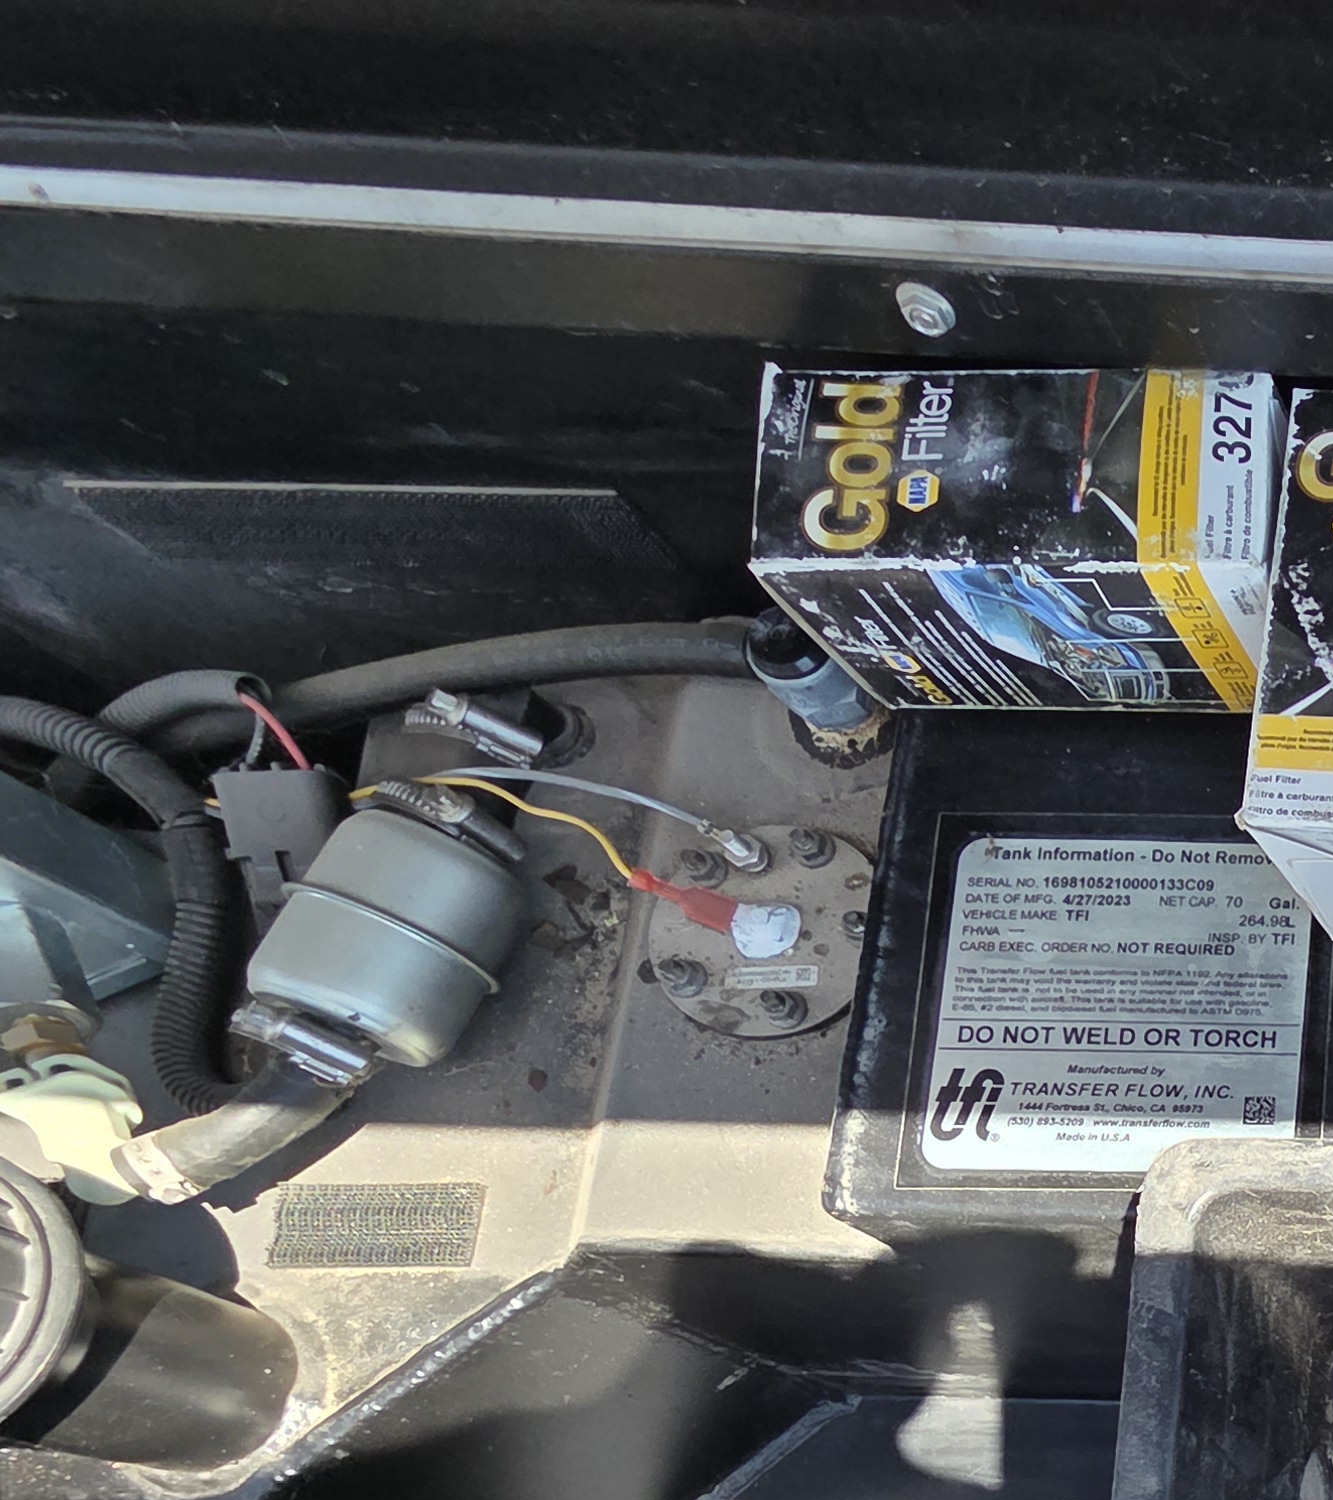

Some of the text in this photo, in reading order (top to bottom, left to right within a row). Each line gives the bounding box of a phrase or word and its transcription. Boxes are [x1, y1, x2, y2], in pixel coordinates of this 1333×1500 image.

[902, 381, 953, 461] Filter
[802, 381, 903, 551] Gold
[908, 476, 929, 505] NAPA
[993, 847, 1273, 866] Tank Information Do Not Remov
[967, 877, 1012, 889] SERIAL
[966, 893, 1131, 907] DATE OF 4/27/2023
[1159, 896, 1300, 910] NET 70 Gal.
[963, 908, 1089, 921] VEHICLE MAKE TFI
[1239, 915, 1295, 928] 264.98L
[963, 926, 1001, 936] FHWA
[1271, 934, 1295, 945] TFI
[960, 941, 1235, 956] CARB ORDER NOT REQUIRED
[958, 1026, 1277, 1049] DO NOT WELD OR TORCH
[1067, 1064, 1146, 1075] Manufactured
[1010, 1083, 1233, 1100] TRANSFER FLOW, INC.
[1018, 1103, 1043, 1111] 1444
[1007, 1118, 1034, 1127] (530)
[1093, 1119, 1210, 1130] www.transferflow.com
